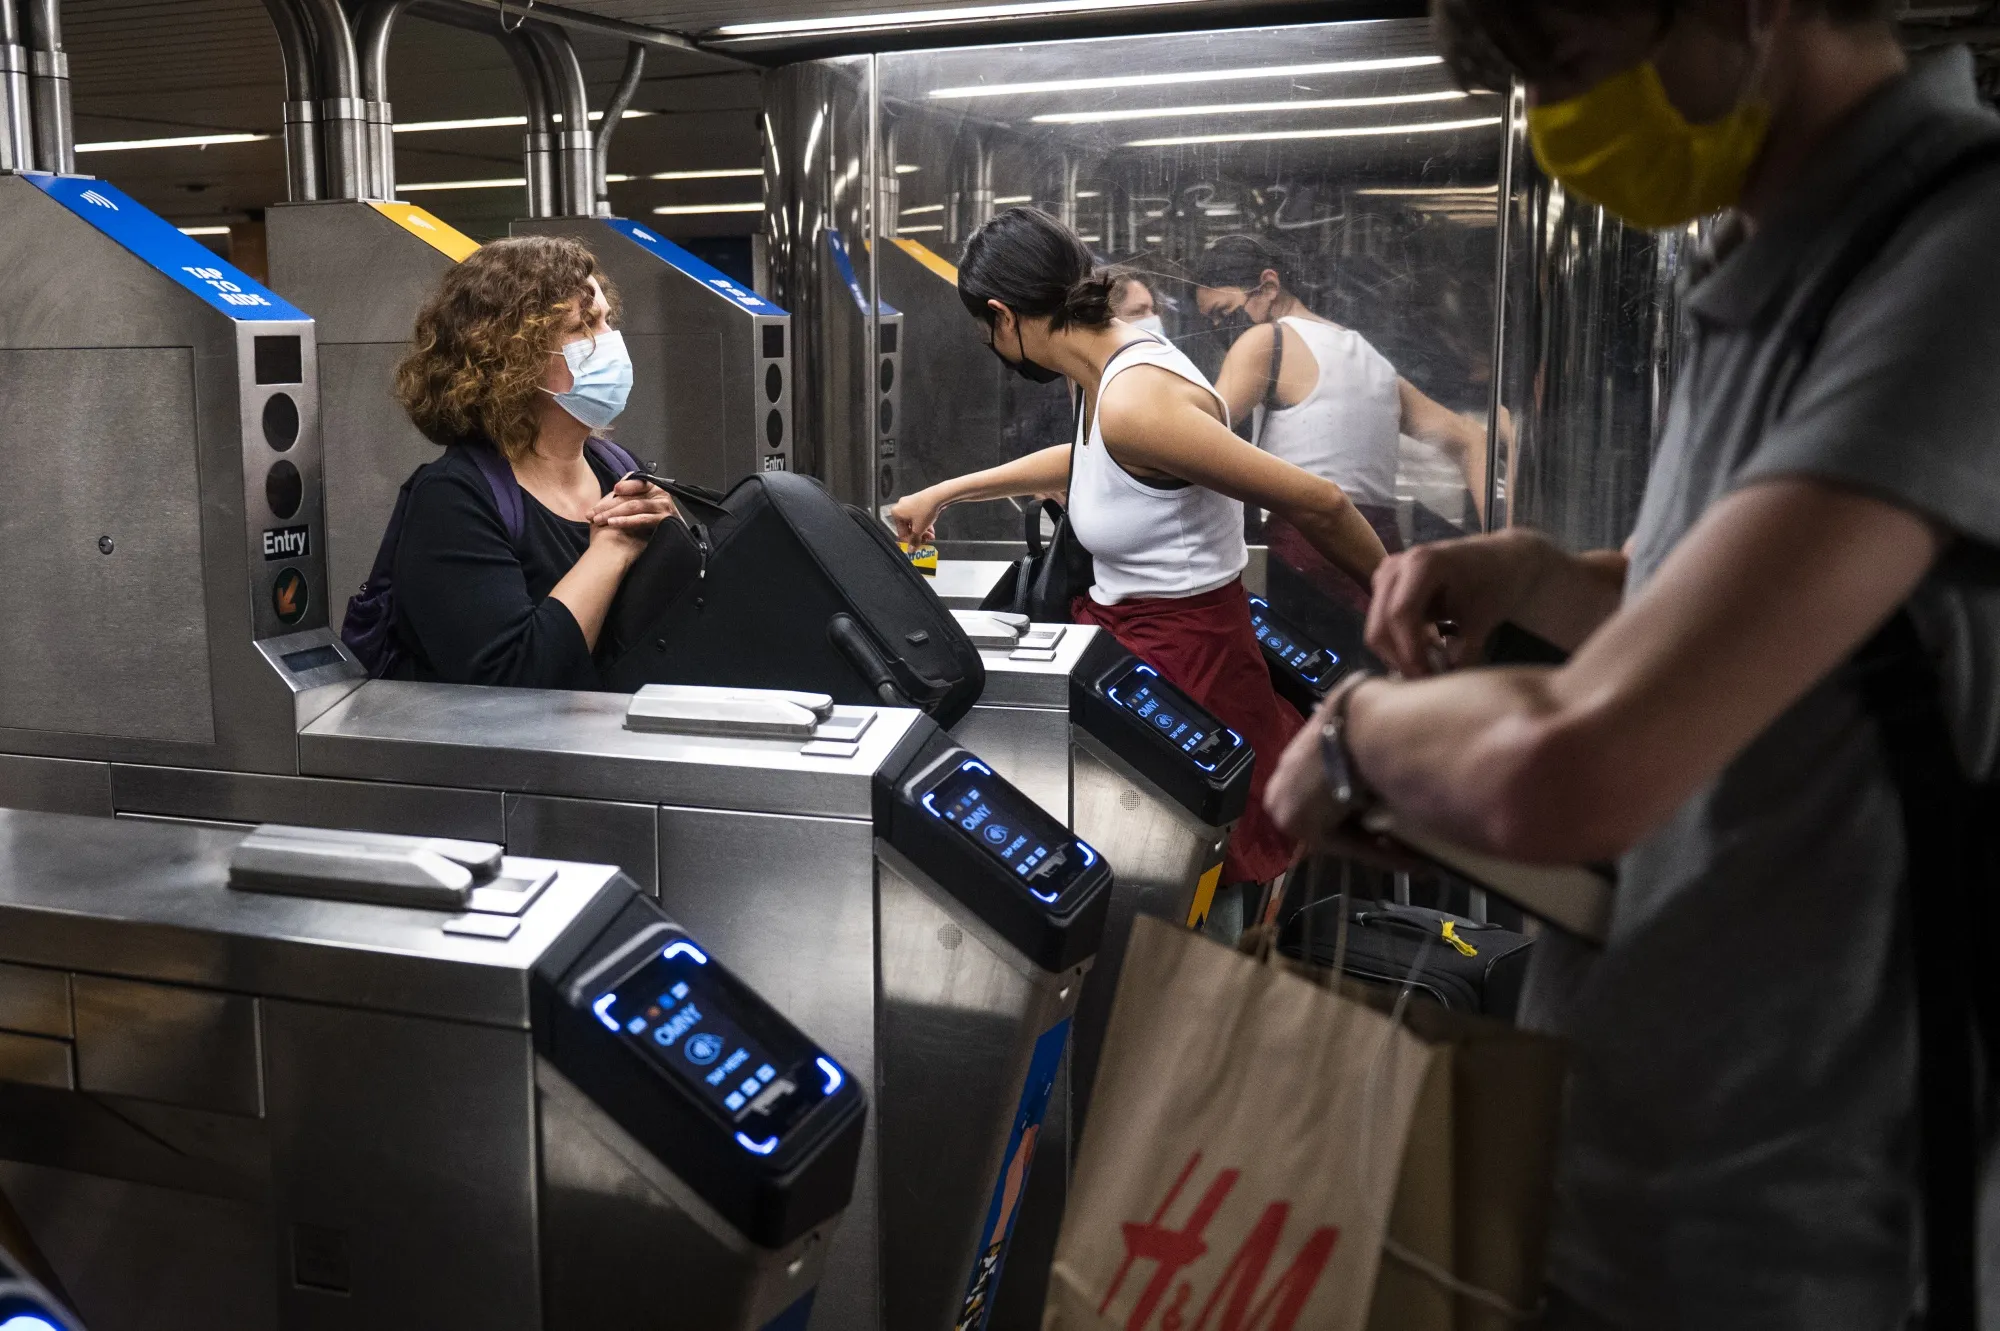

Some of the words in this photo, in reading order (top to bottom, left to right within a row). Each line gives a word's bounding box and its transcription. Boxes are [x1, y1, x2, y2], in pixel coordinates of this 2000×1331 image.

[181, 267, 223, 279] TAP
[206, 280, 241, 292] TO
[218, 293, 272, 306] RIDE
[764, 456, 784, 471] Entry
[263, 530, 306, 555] Entry
[1137, 698, 1159, 718] OMNY
[961, 804, 991, 830] OMNY
